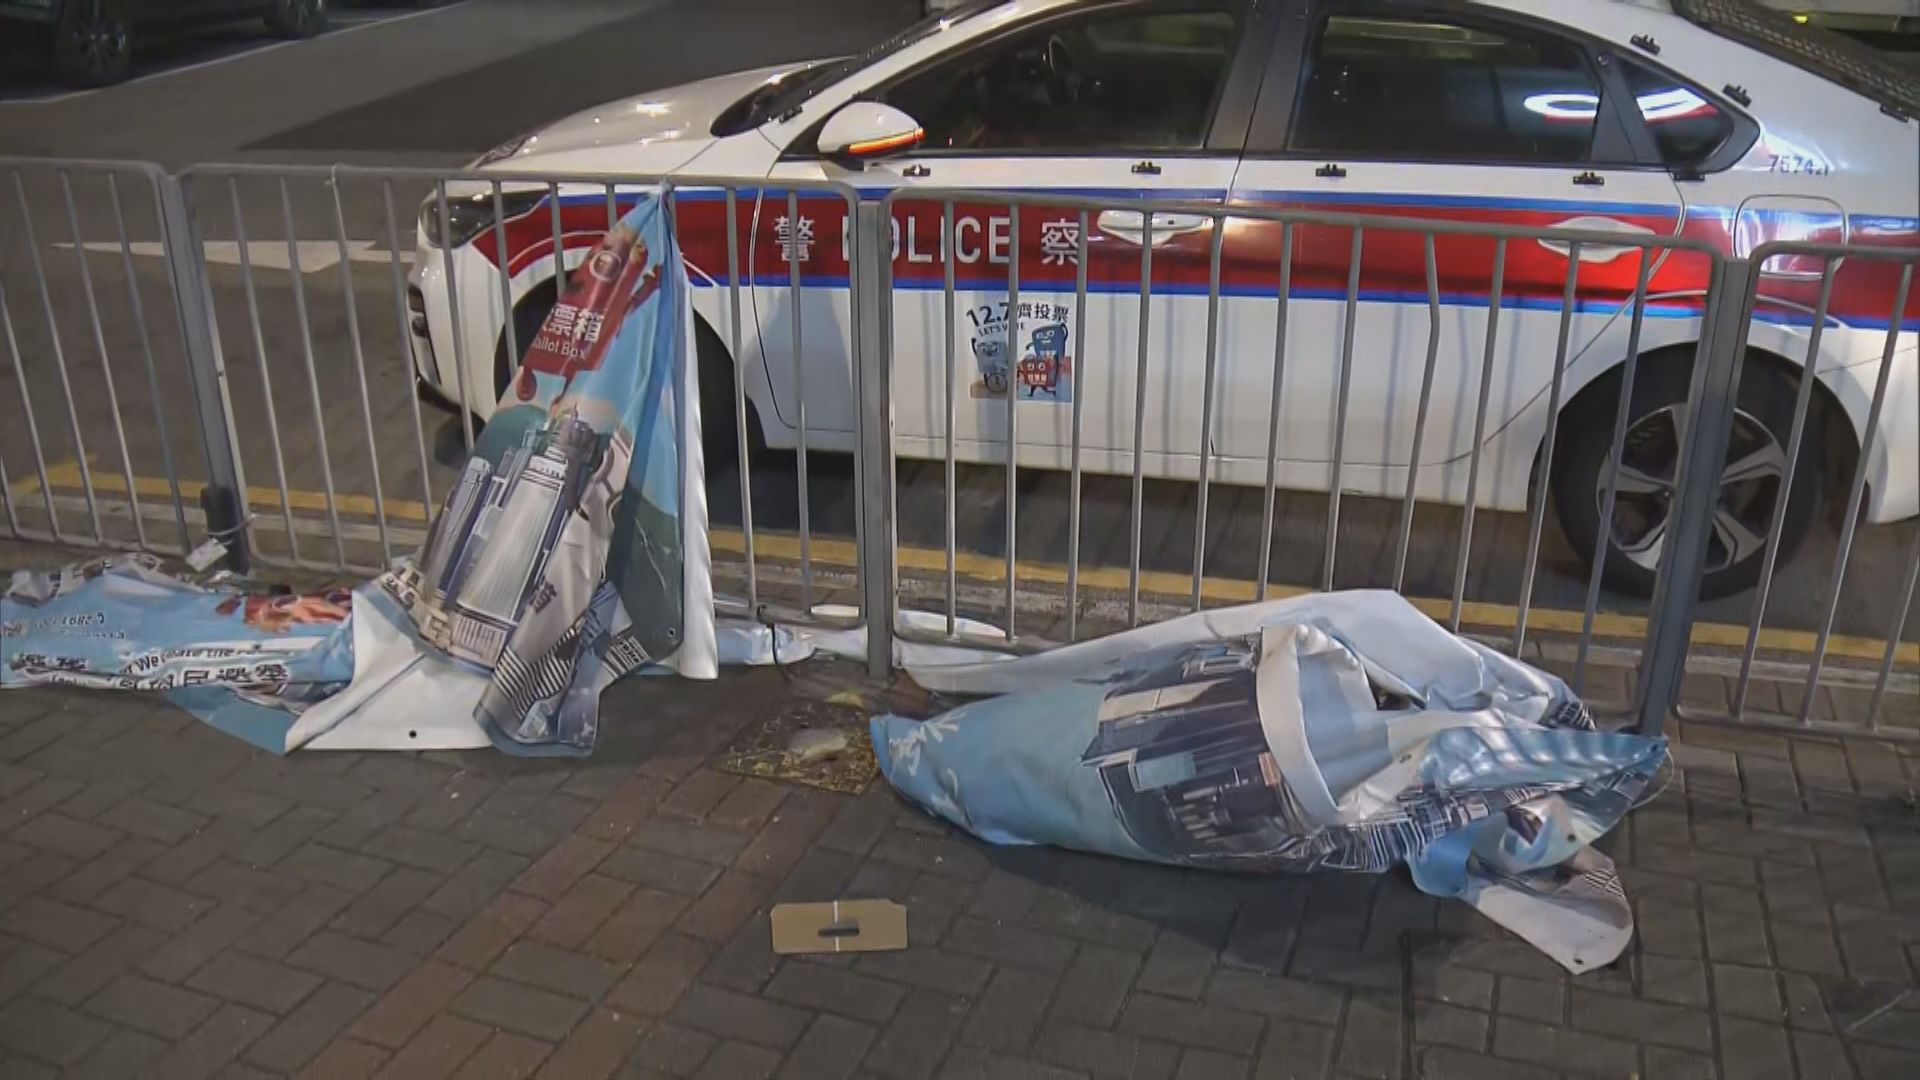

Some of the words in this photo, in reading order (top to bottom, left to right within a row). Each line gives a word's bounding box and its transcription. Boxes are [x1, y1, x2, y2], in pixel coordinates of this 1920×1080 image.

[774, 215, 815, 262] 警
[1041, 217, 1079, 266] 察
[533, 337, 560, 353] allot
